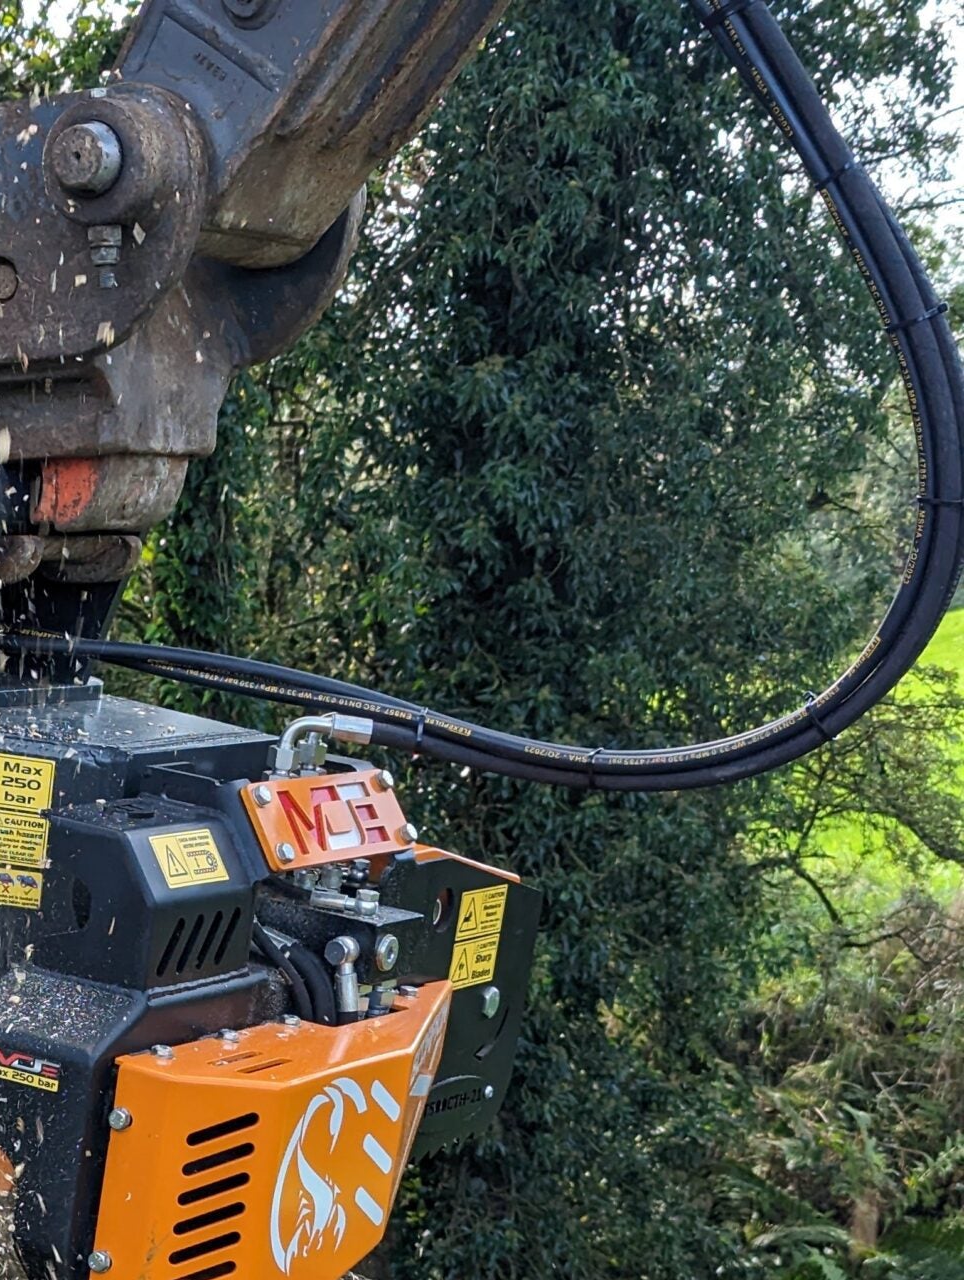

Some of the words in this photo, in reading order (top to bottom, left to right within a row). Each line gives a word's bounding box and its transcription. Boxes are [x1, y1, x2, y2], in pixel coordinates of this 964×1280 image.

[3, 761, 43, 777] Max
[1, 775, 42, 791] 250
[4, 791, 36, 805] bar
[4, 817, 44, 829] CAUTION
[16, 830, 44, 840] hazard
[475, 953, 492, 964] Sharp
[471, 968, 490, 979] Blades
[12, 1070, 35, 1083] 250
[38, 1078, 56, 1089] bar
